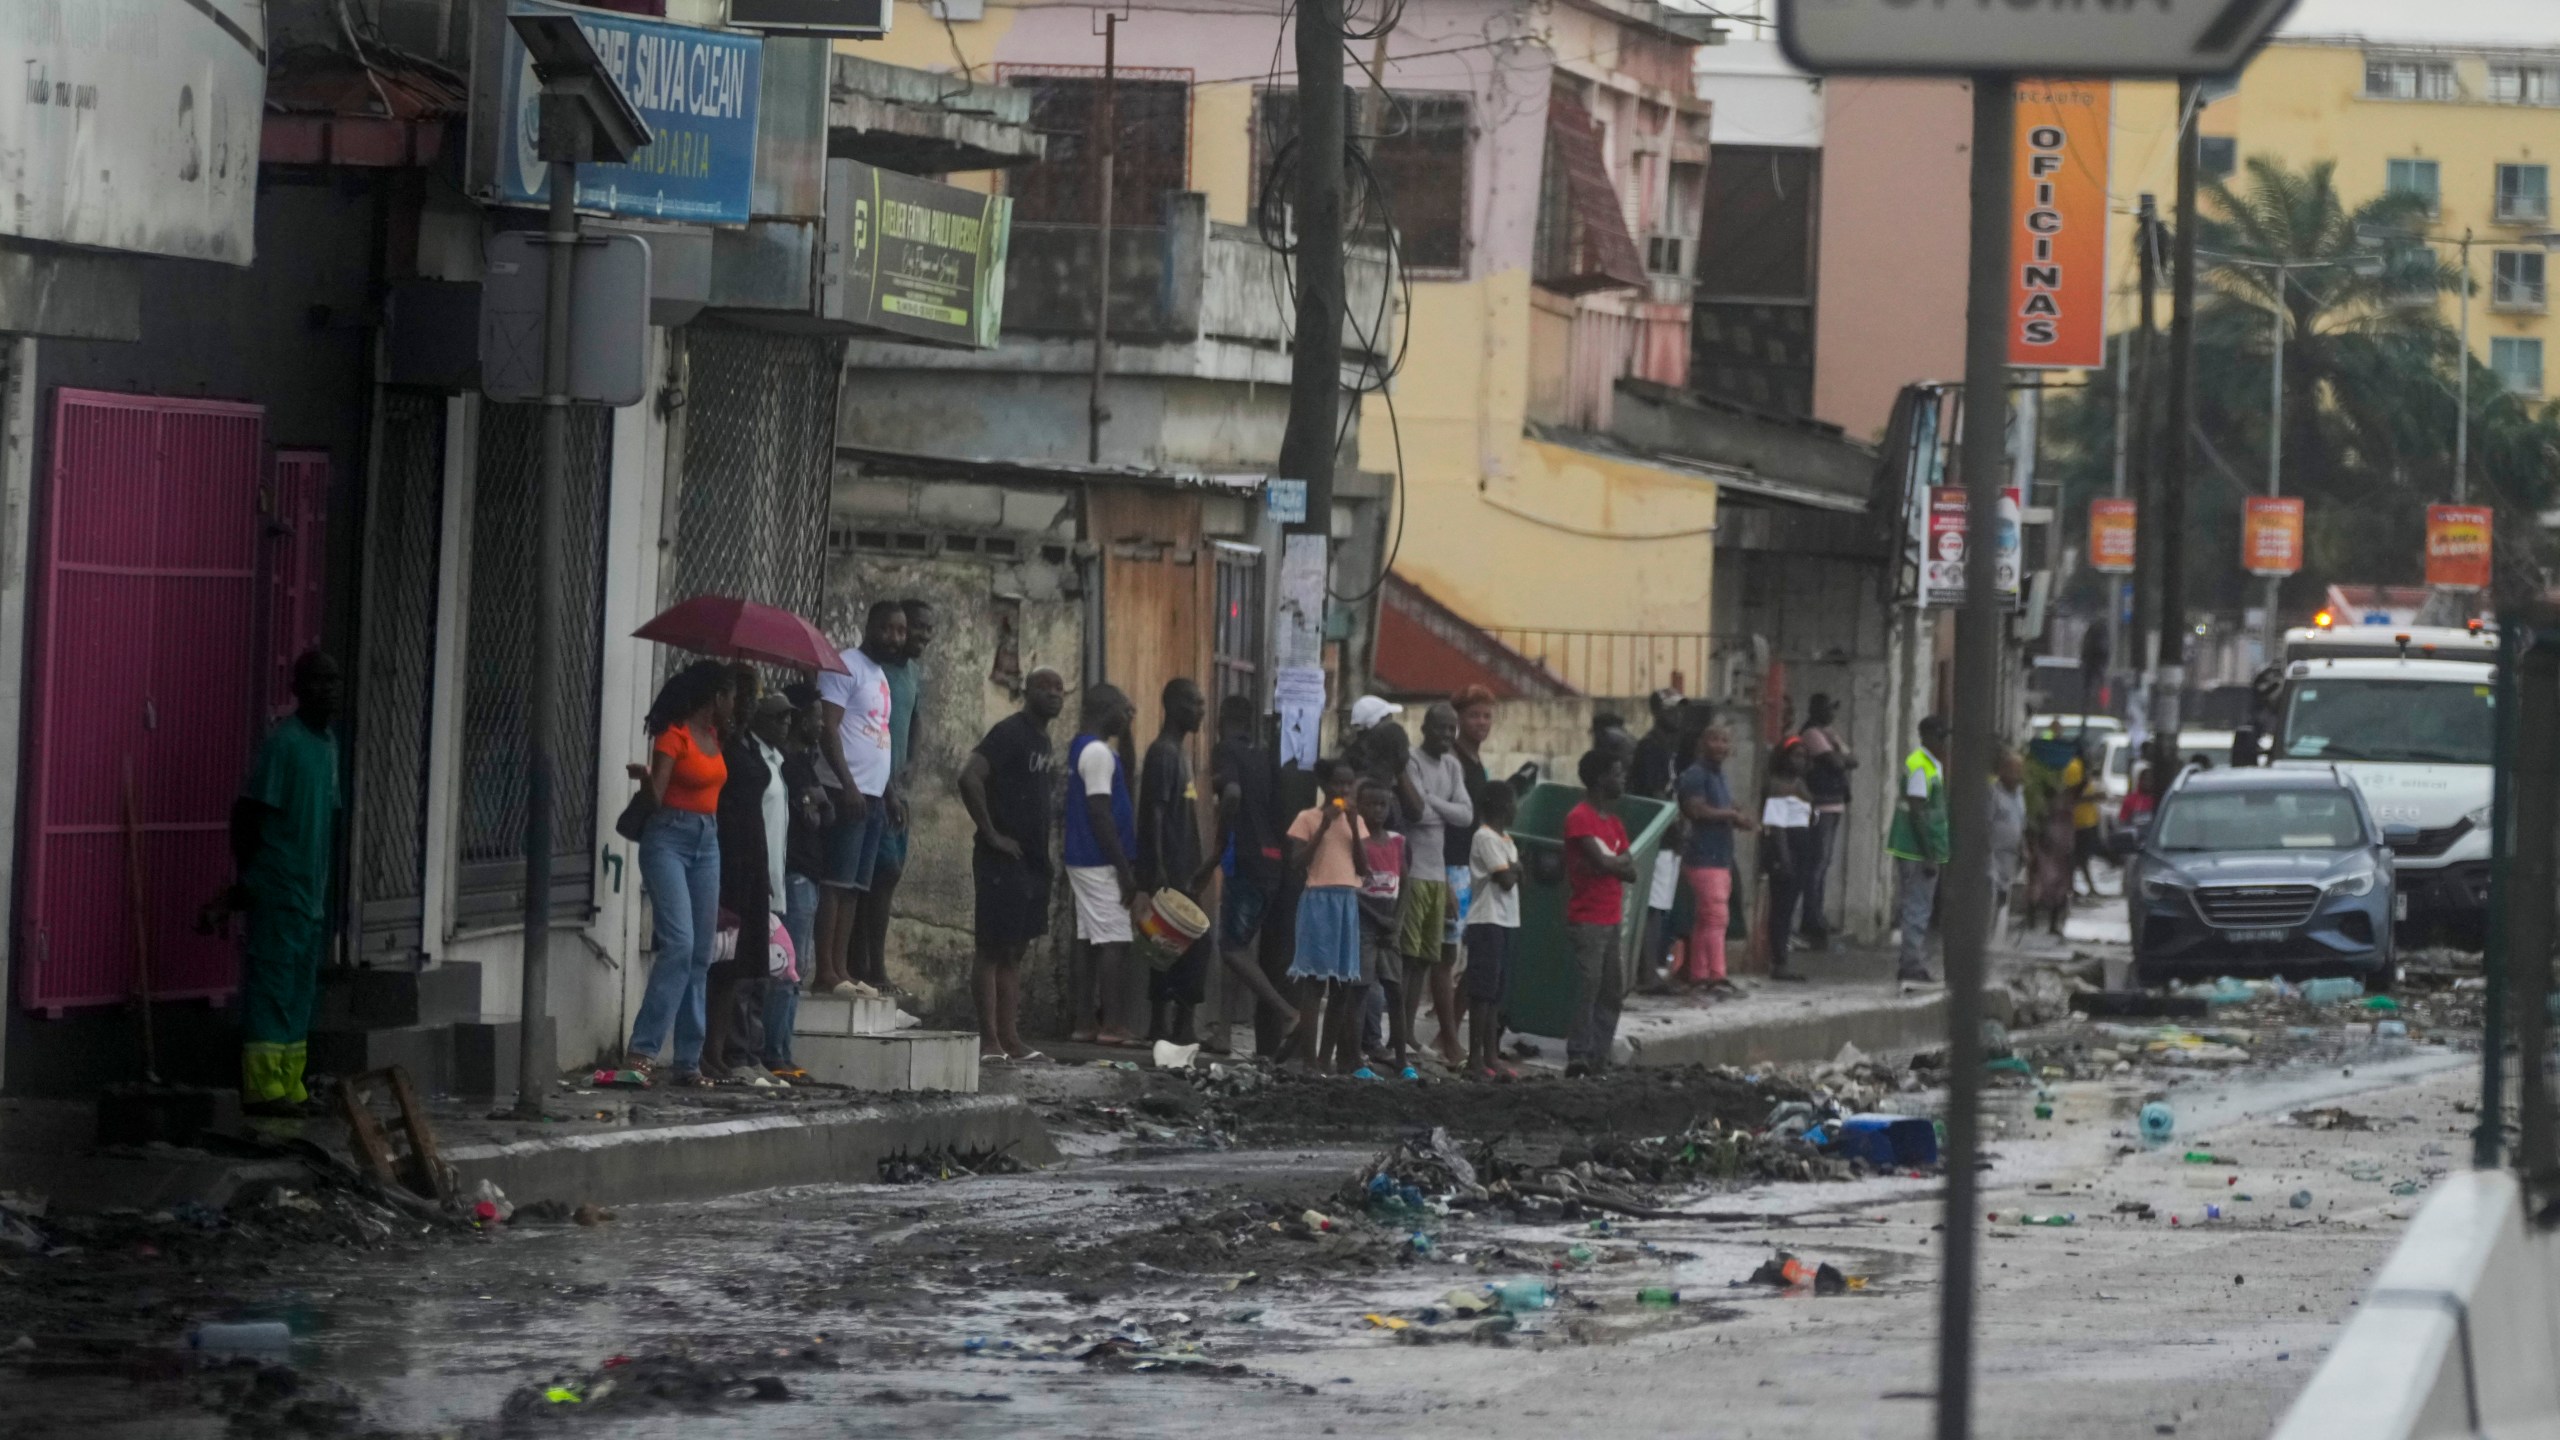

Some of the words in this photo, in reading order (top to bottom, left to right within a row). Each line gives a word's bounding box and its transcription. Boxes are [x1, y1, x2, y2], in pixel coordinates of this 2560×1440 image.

[634, 34, 685, 113] SILVA
[690, 43, 745, 119] CLEAN
[2021, 126, 2064, 345] OFICINAS
